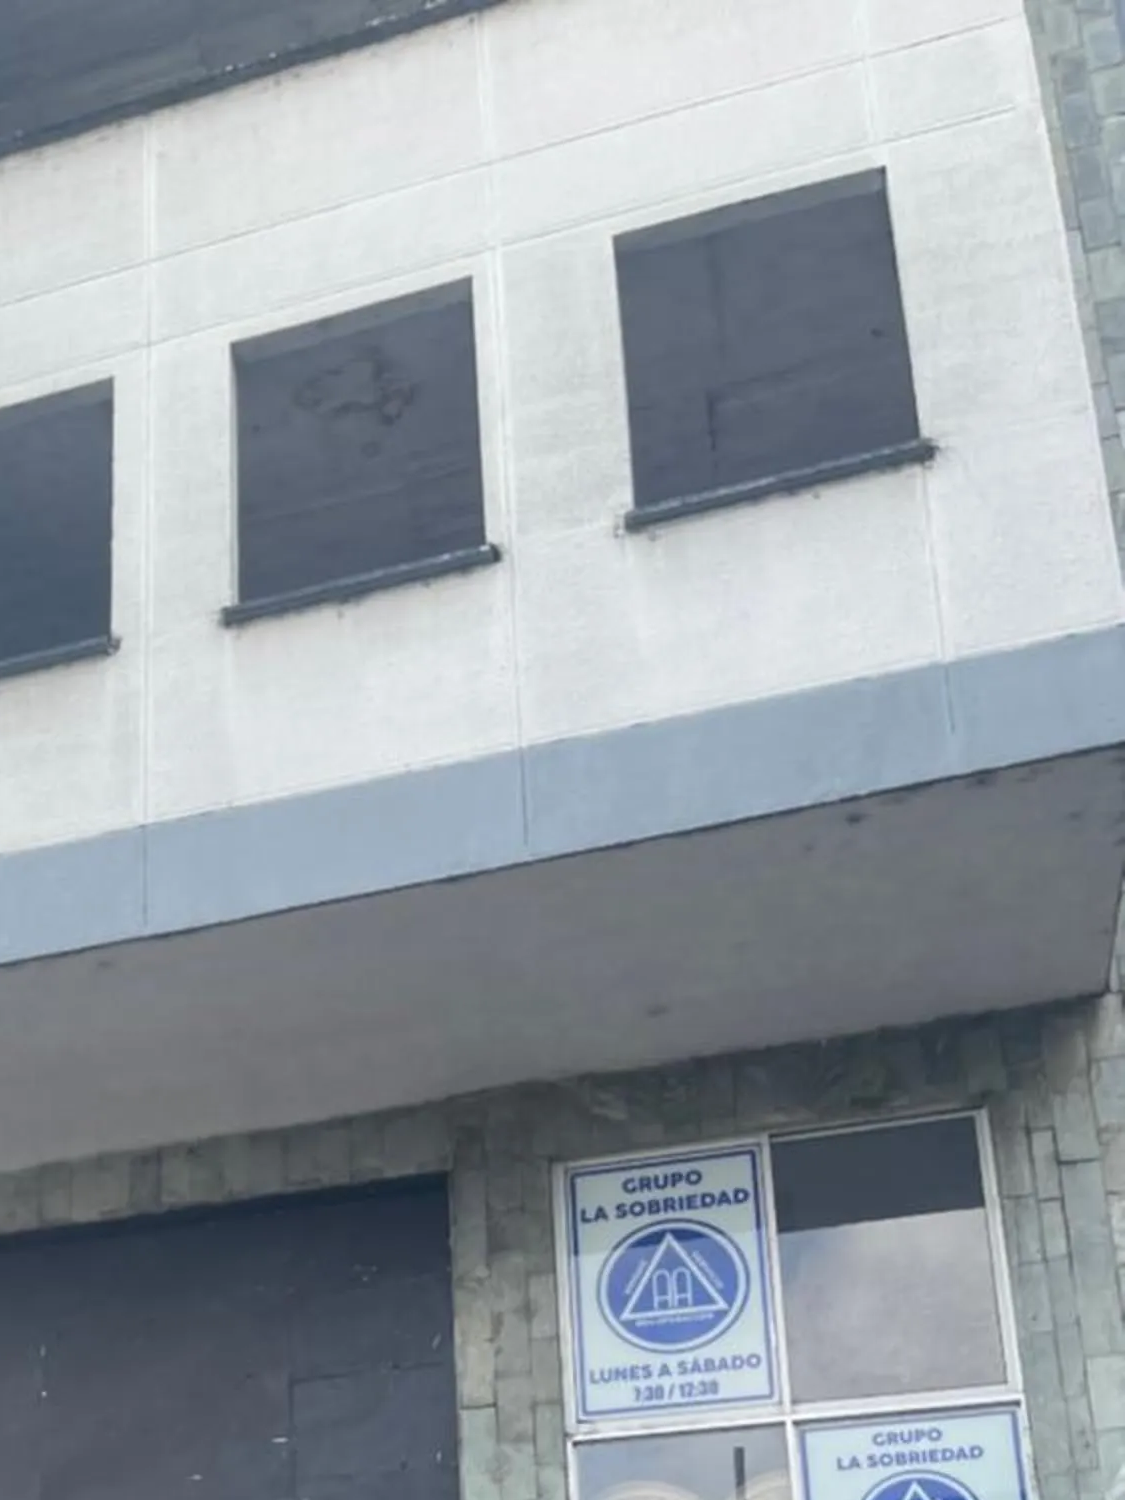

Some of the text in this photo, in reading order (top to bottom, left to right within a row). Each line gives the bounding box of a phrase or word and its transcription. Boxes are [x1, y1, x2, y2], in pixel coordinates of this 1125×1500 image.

[622, 1170, 703, 1194] GRUPO
[580, 1188, 750, 1224] LA SOBRIEDAD
[589, 1353, 762, 1385] LUNES A SÁBADO
[872, 1428, 943, 1447] GRUPO
[836, 1445, 985, 1471] LA SOBRIEDAD
